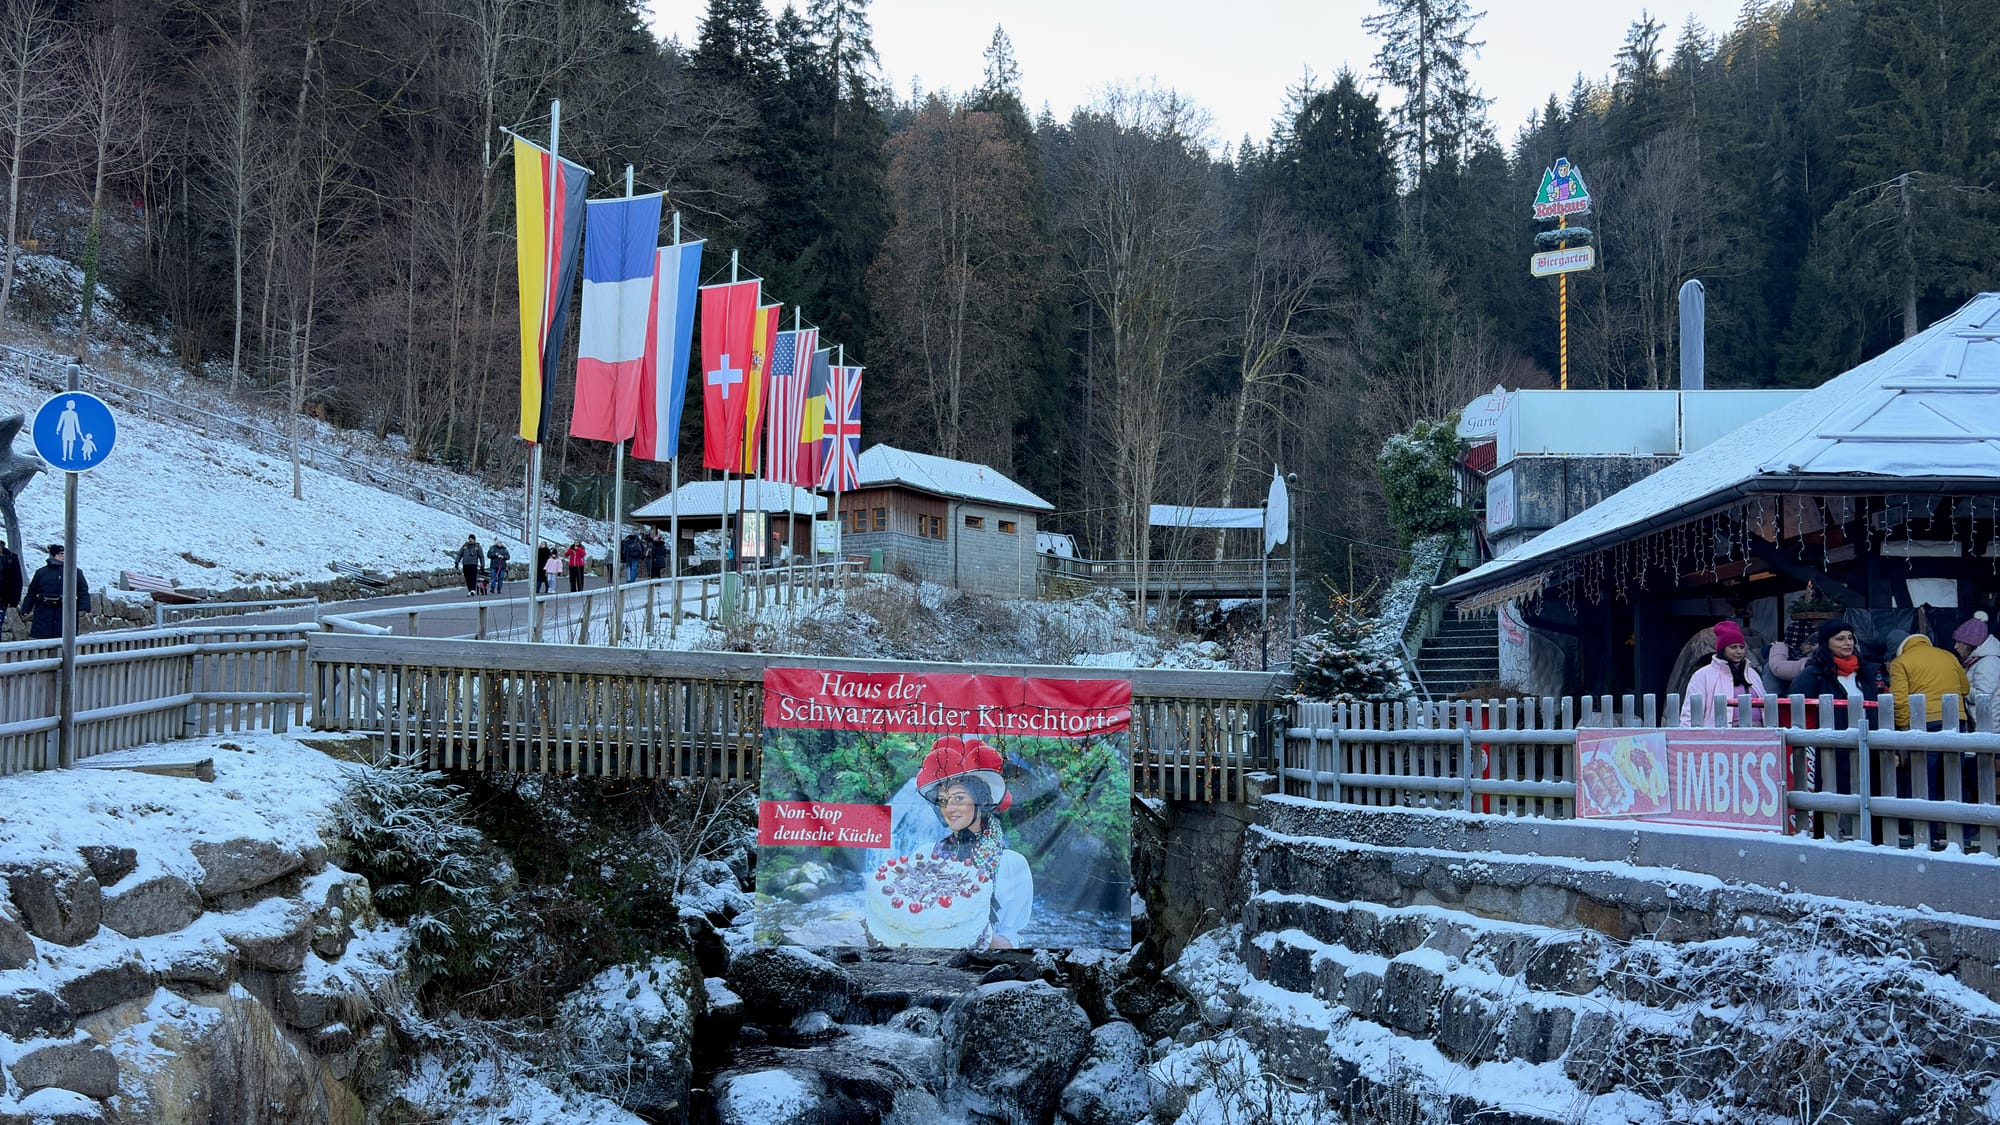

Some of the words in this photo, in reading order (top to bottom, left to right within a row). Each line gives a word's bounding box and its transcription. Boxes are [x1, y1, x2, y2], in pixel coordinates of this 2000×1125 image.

[1535, 200, 1586, 218] Rothaus
[1537, 253, 1589, 268] Biergarten
[1484, 396, 1509, 411] Lil
[1466, 416, 1497, 432] Garte
[819, 673, 882, 699] Haus
[887, 674, 927, 700] der
[780, 697, 970, 726] Schwarzwälder
[977, 704, 1119, 732] Kirschtorte
[1676, 751, 1779, 817] IMBISS
[774, 804, 843, 824] Non-Stop
[773, 825, 835, 841] deutsche
[837, 827, 883, 843] Küche
